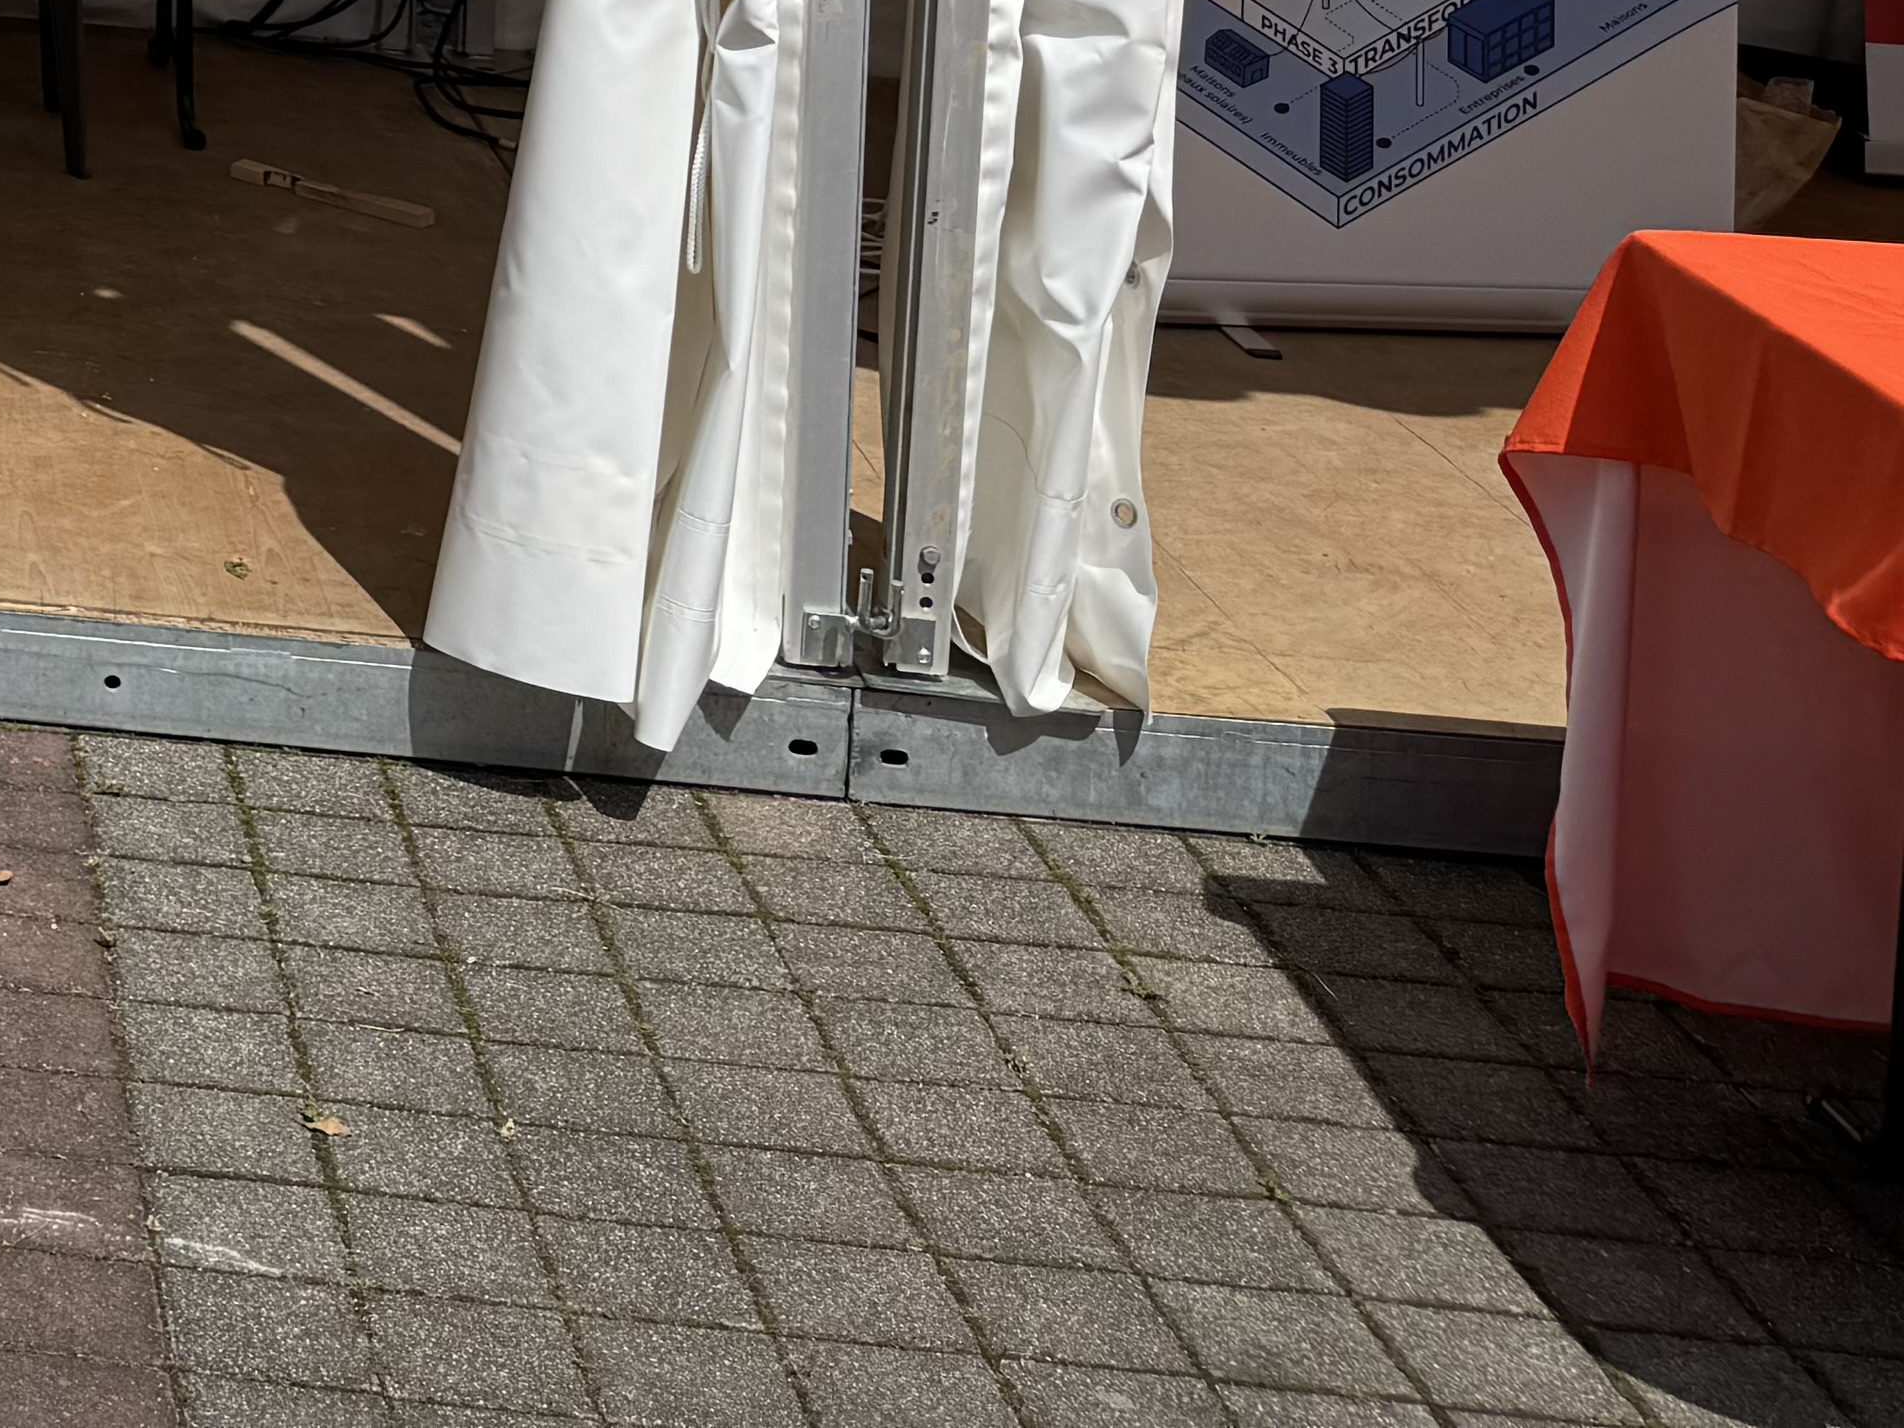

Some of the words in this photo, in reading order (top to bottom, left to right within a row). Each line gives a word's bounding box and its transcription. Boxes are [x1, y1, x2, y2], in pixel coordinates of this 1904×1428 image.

[1599, 0, 1648, 33] Maisons
[1260, 14, 1323, 66] PHASE
[1327, 60, 1339, 75] 3
[1458, 74, 1526, 117] Entreprises
[1343, 90, 1538, 217] CONSOMMATION
